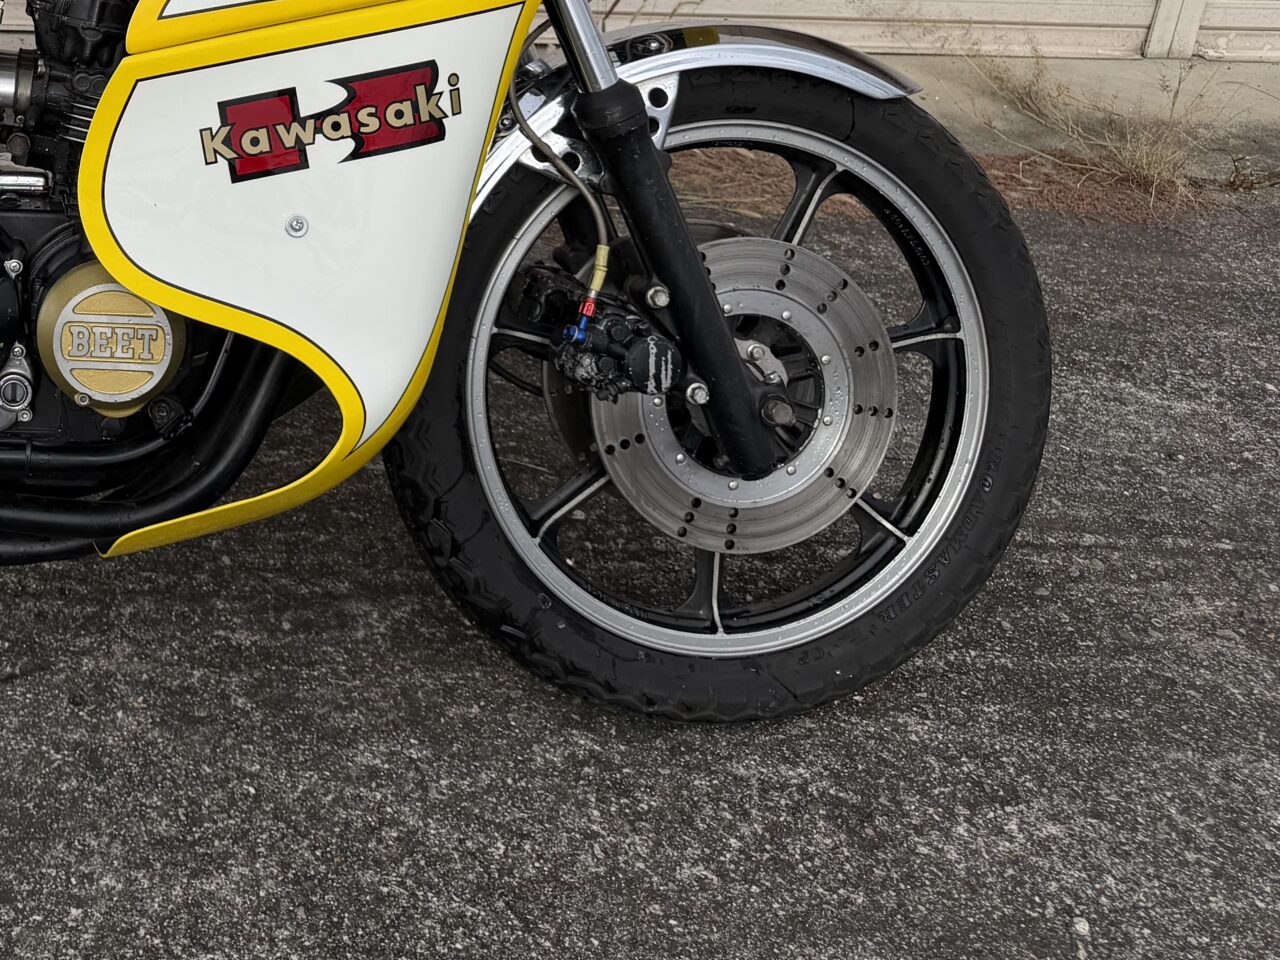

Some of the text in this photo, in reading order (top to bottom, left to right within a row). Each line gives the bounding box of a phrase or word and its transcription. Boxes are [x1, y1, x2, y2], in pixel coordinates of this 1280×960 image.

[199, 72, 462, 165] Kawasaki
[68, 325, 158, 360] BEET
[879, 453, 1001, 621] ROADMASTER
